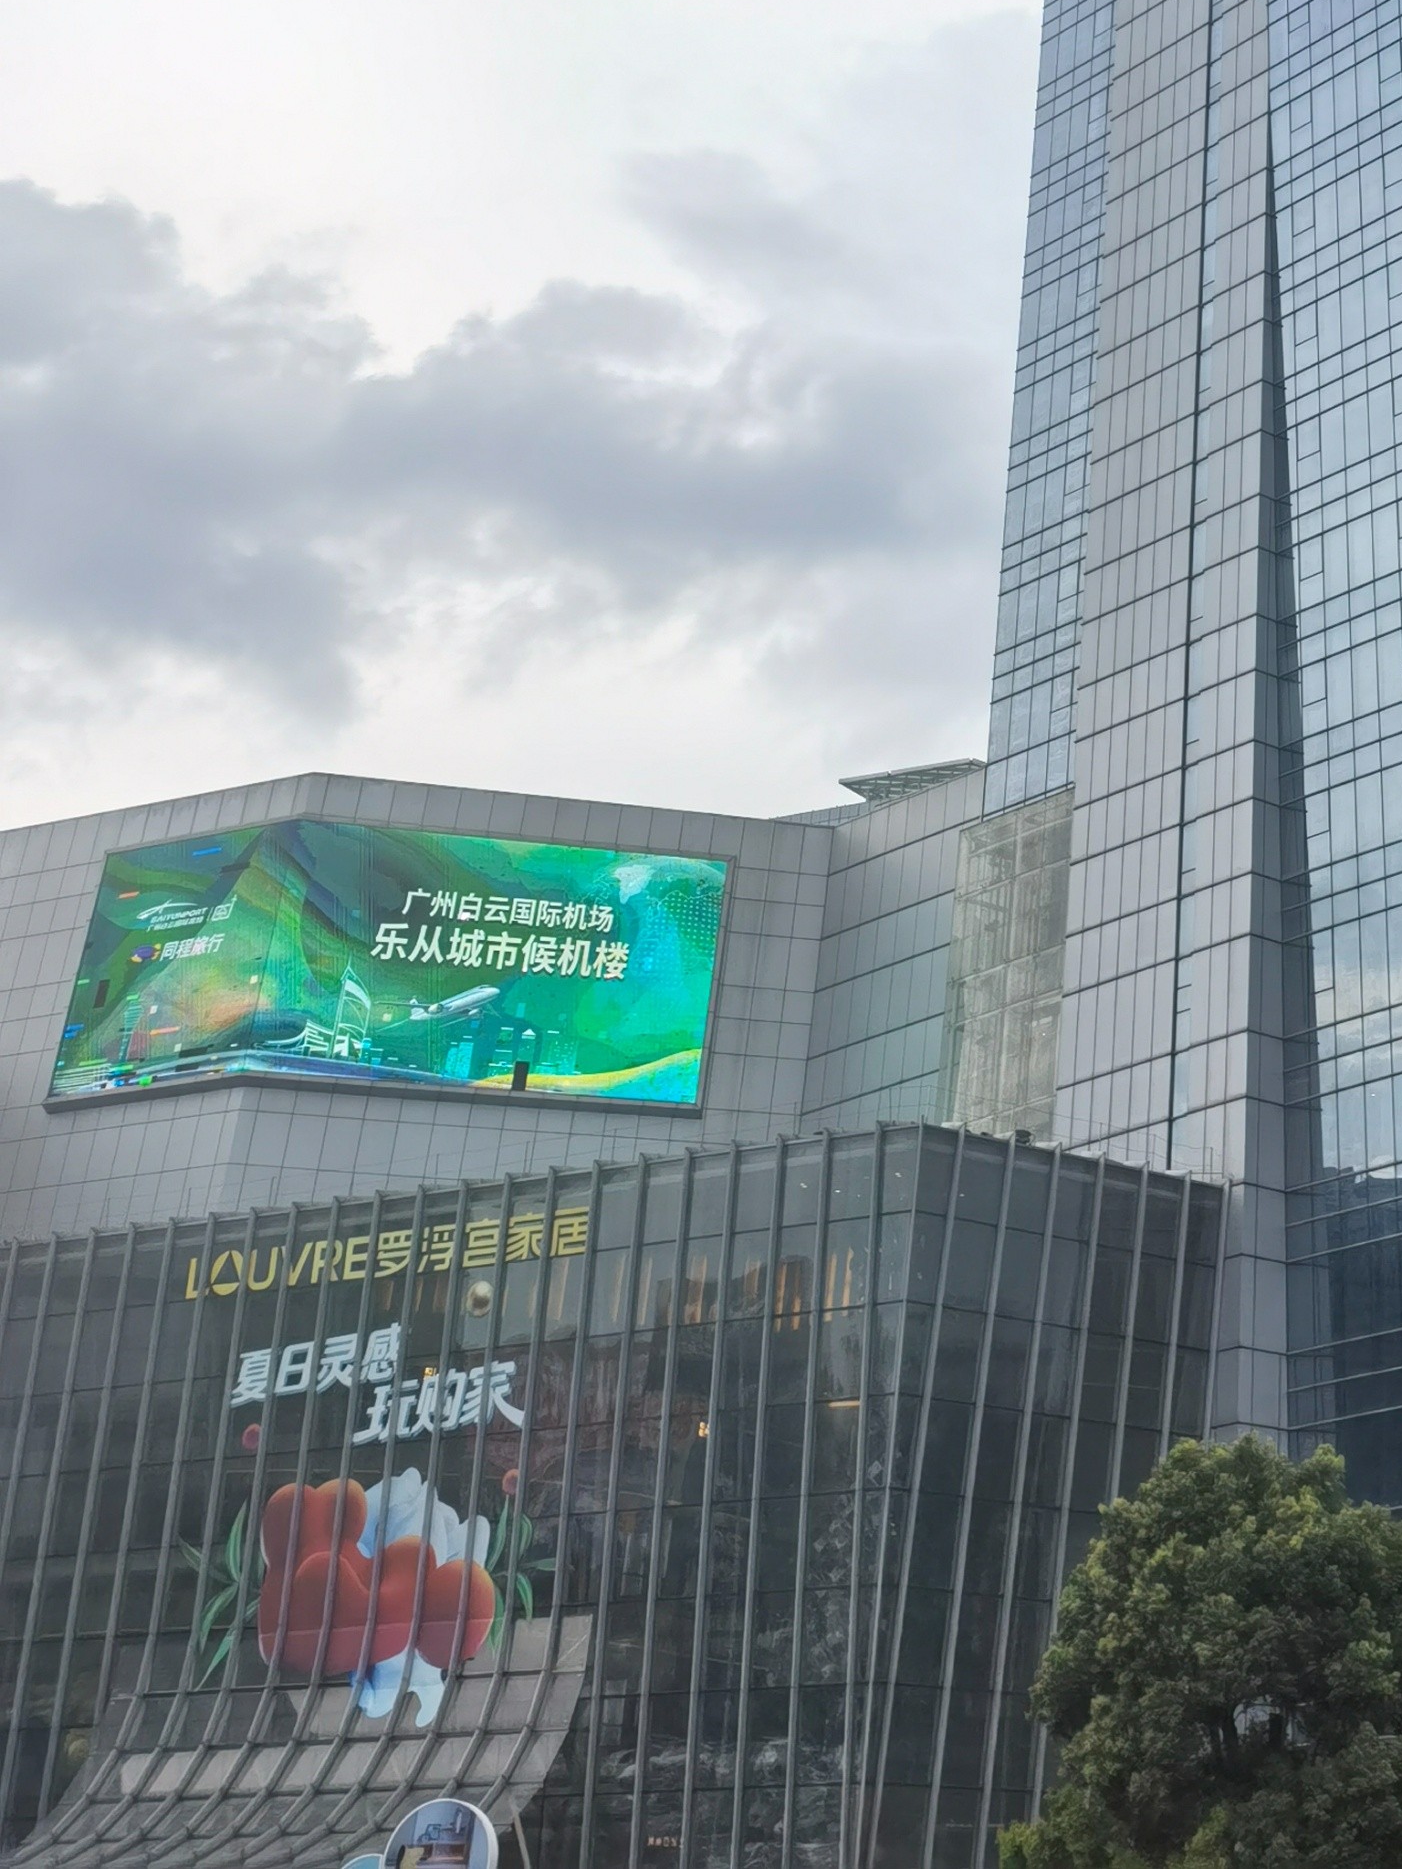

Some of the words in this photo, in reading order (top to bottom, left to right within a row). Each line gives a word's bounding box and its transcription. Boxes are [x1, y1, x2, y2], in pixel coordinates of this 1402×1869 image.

[402, 888, 614, 933] 广州白云国际机场
[160, 933, 225, 961] 同程旅行
[371, 922, 629, 980] 乐从城市候机楼
[185, 1235, 370, 1299] LOUVRE
[374, 1207, 590, 1278] 罗浮宫家居
[230, 1322, 402, 1408] 夏日灵感
[352, 1361, 526, 1446] 玩购家
